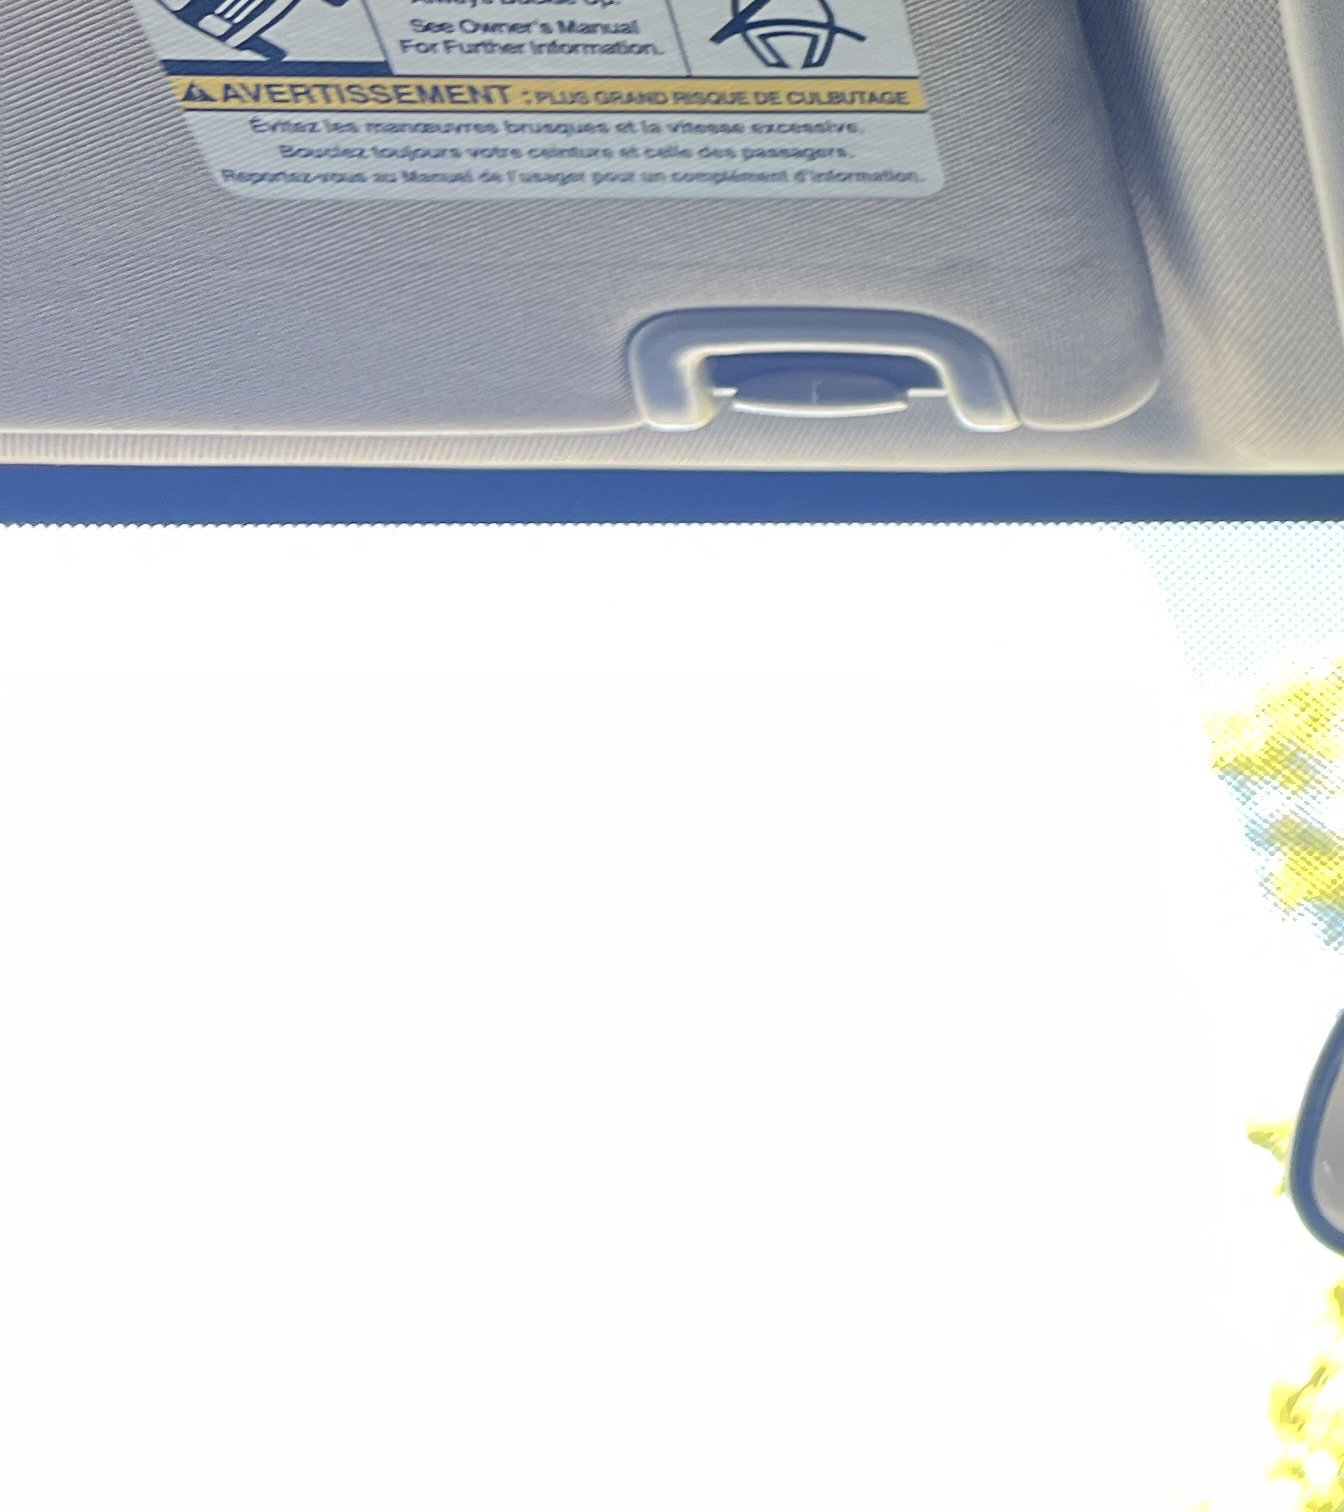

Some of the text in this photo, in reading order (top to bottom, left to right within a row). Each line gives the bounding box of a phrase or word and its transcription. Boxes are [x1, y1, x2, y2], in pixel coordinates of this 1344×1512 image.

[410, 18, 640, 35] See Owner's Manual
[400, 39, 439, 54] For
[443, 39, 526, 55] Further
[222, 83, 513, 105] AVERTISSEMENT
[535, 91, 589, 105] PLUS
[594, 91, 668, 105] GRAND
[673, 91, 749, 105] RISQUE
[753, 91, 782, 105] DE
[786, 91, 911, 105] CULBUTAGE
[324, 119, 360, 134] les
[615, 120, 638, 134] et
